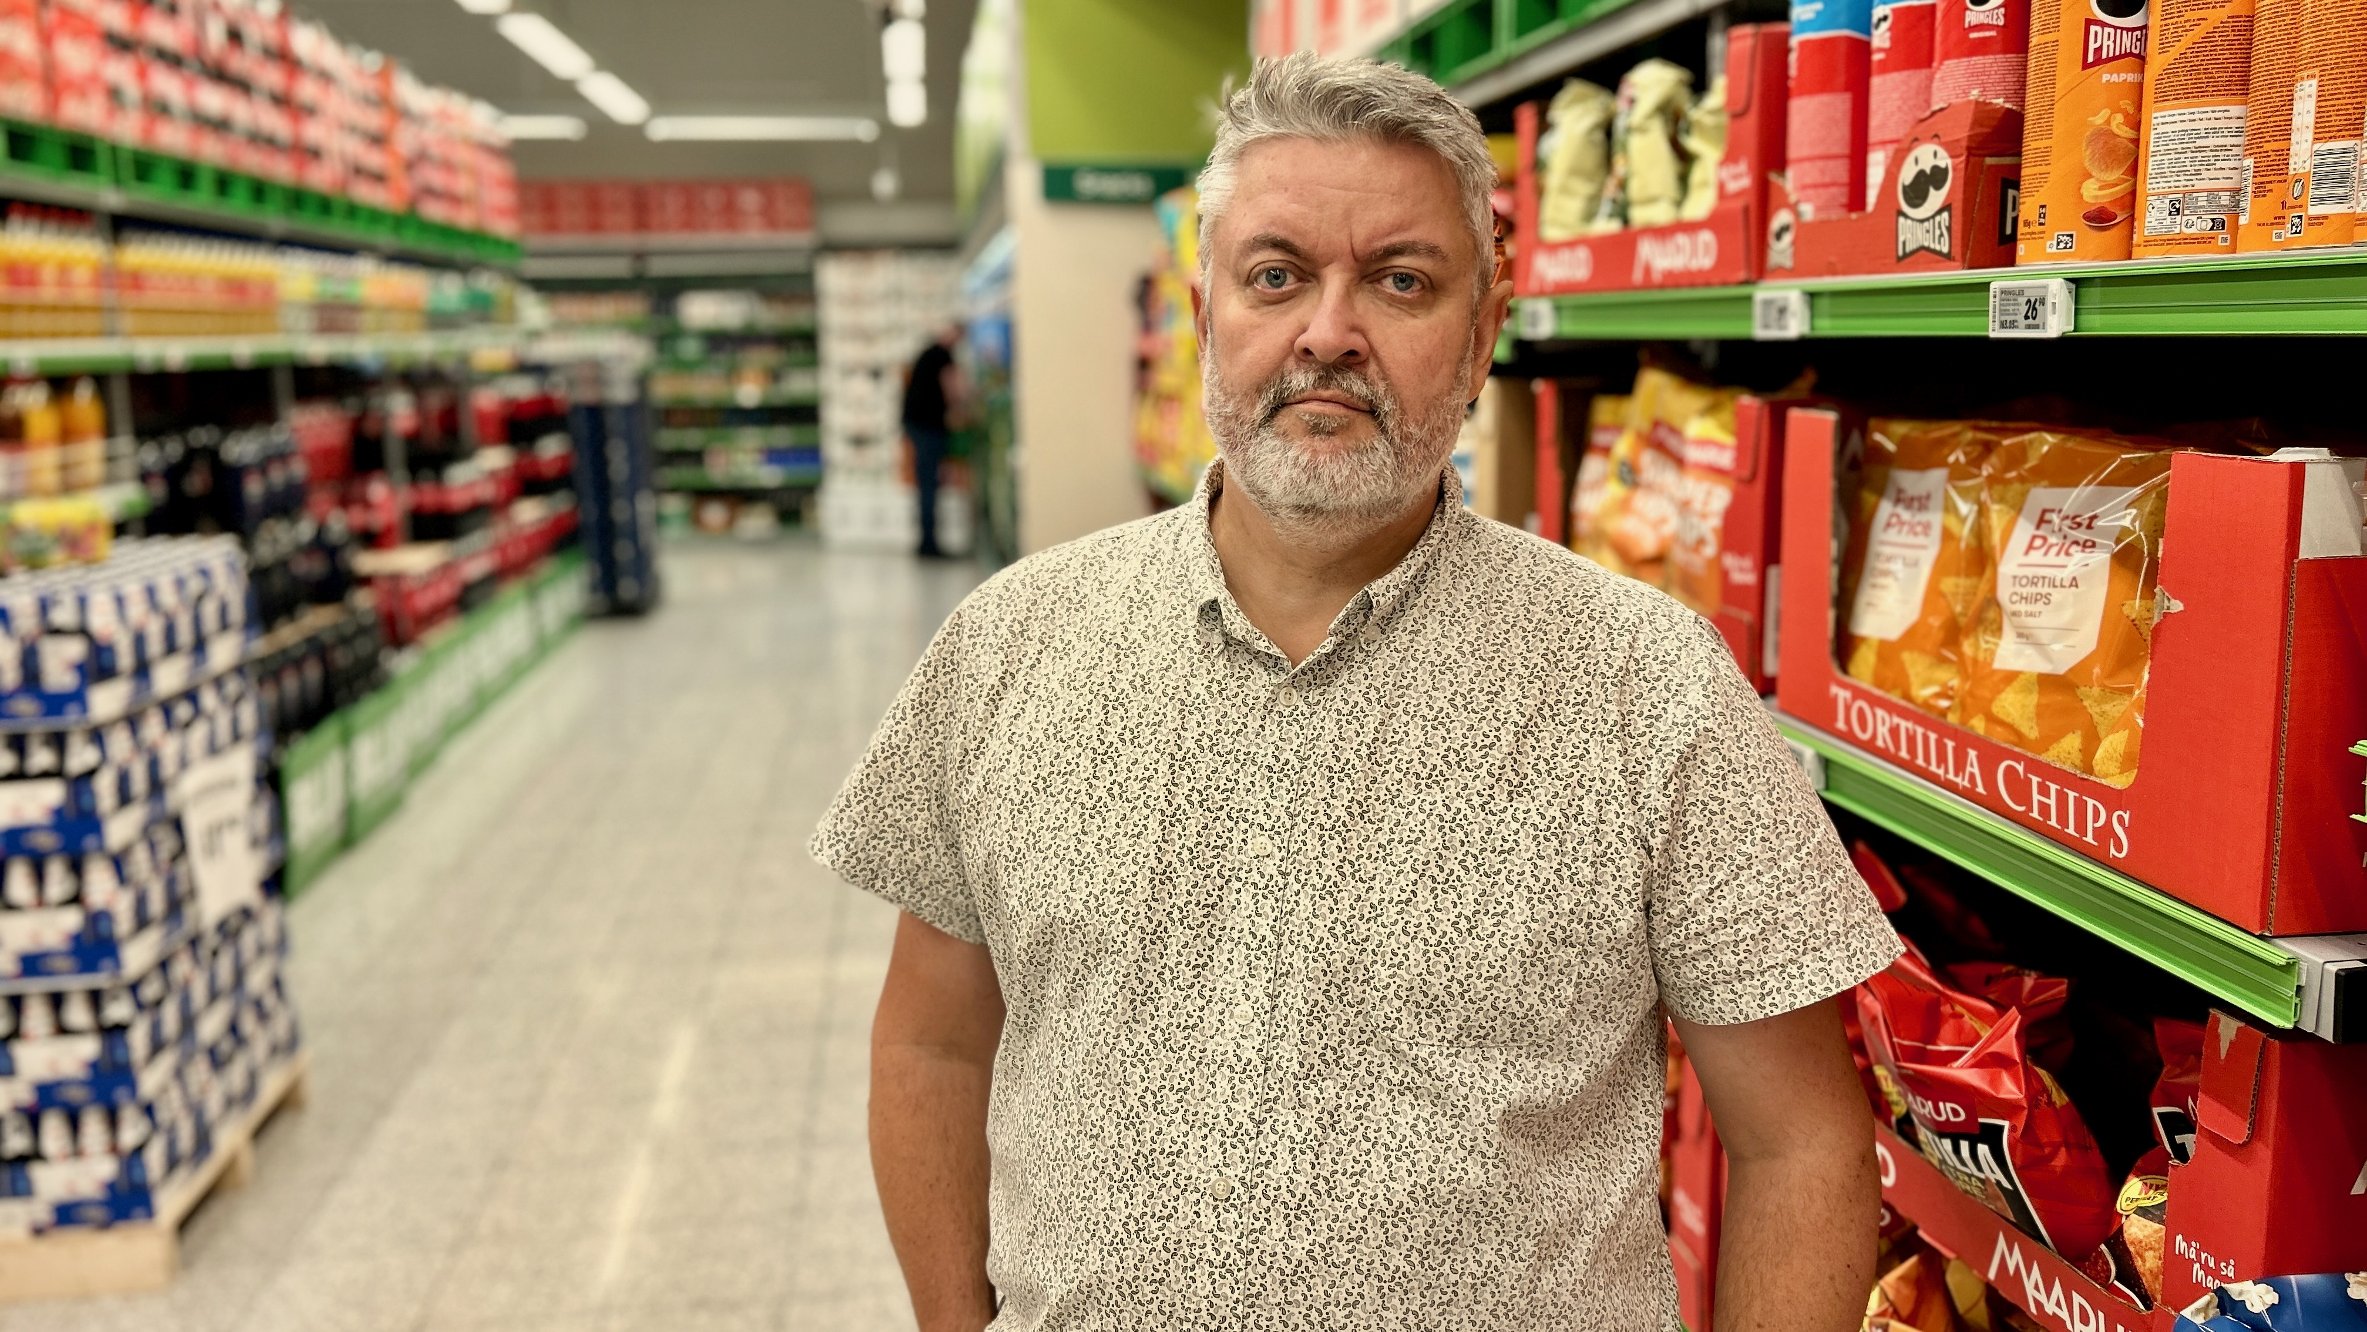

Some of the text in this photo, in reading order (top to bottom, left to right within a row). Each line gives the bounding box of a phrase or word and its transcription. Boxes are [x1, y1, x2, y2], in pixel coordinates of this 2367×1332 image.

[1964, 7, 2005, 29] PRINGLES
[1897, 210, 1949, 257] PRINGLES
[2023, 298, 2038, 321] 26
[2035, 508, 2099, 534] First
[2022, 534, 2097, 558] Price
[2011, 575, 2080, 590] TORTILLA
[2009, 592, 2053, 606] CHIPS
[1829, 685, 2131, 860] TORTILLA CHIPS
[2219, 1258, 2235, 1280] så
